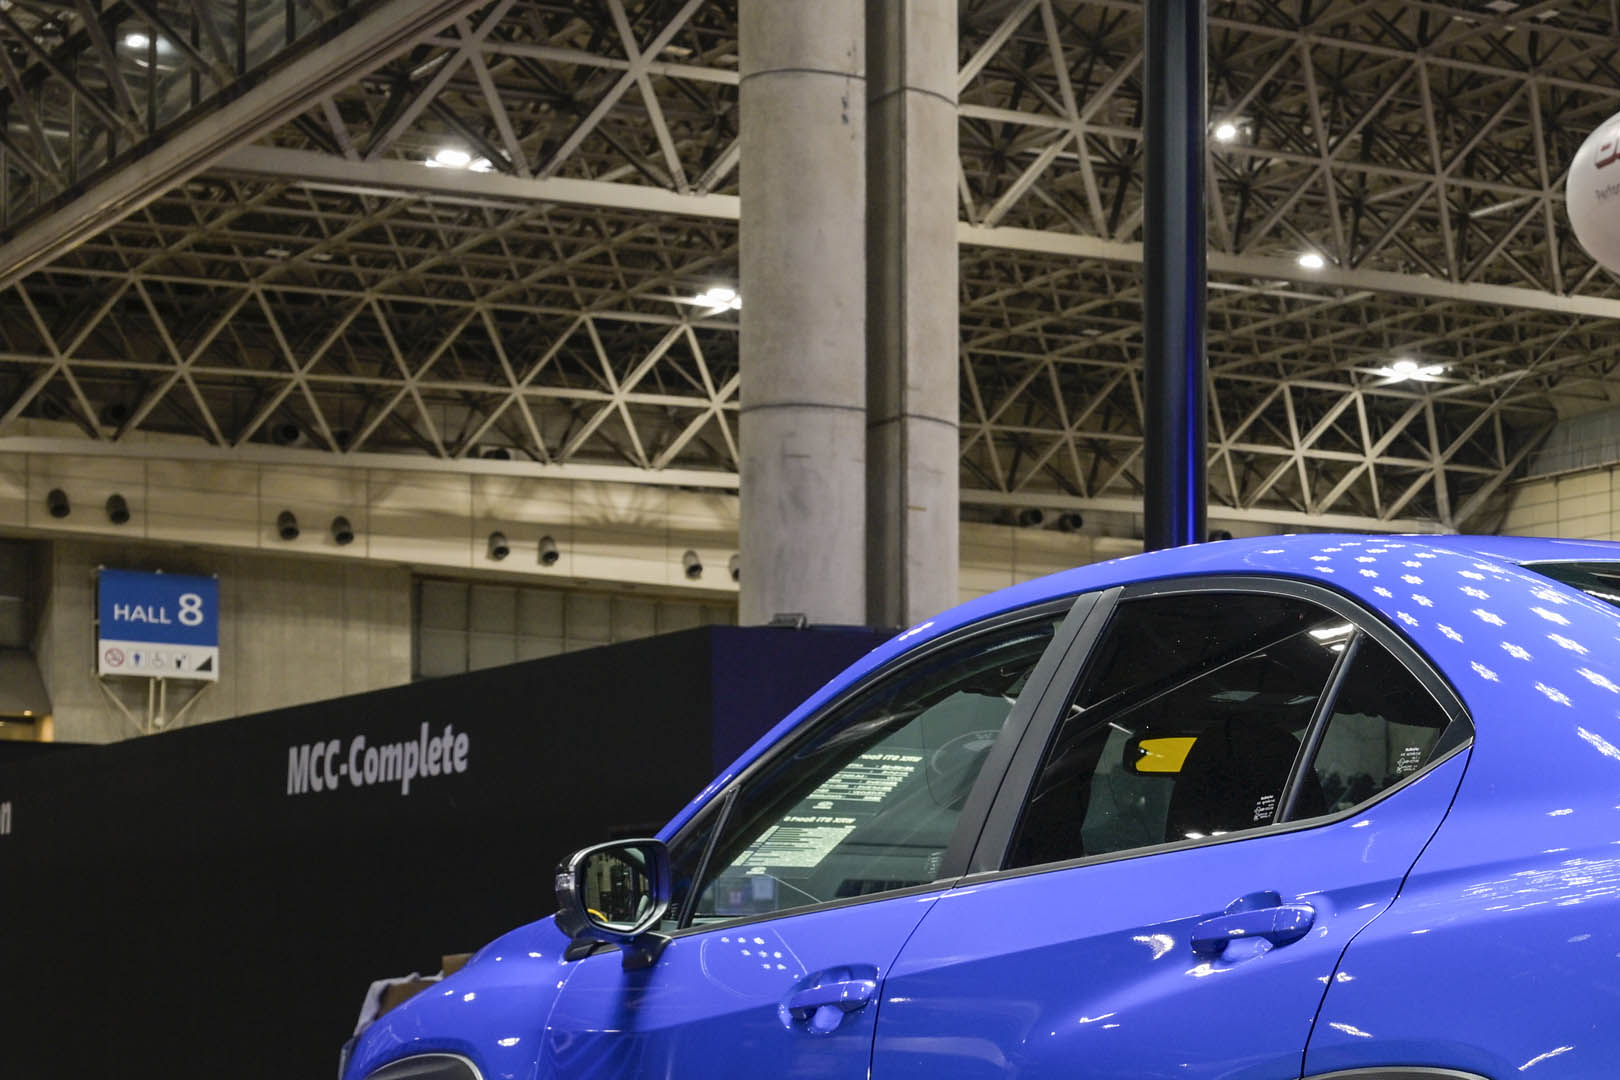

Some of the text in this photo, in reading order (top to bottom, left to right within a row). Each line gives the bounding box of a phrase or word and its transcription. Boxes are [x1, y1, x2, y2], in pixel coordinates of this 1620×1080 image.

[113, 593, 204, 626] HALL 8
[287, 722, 470, 796] MCC-Complete
